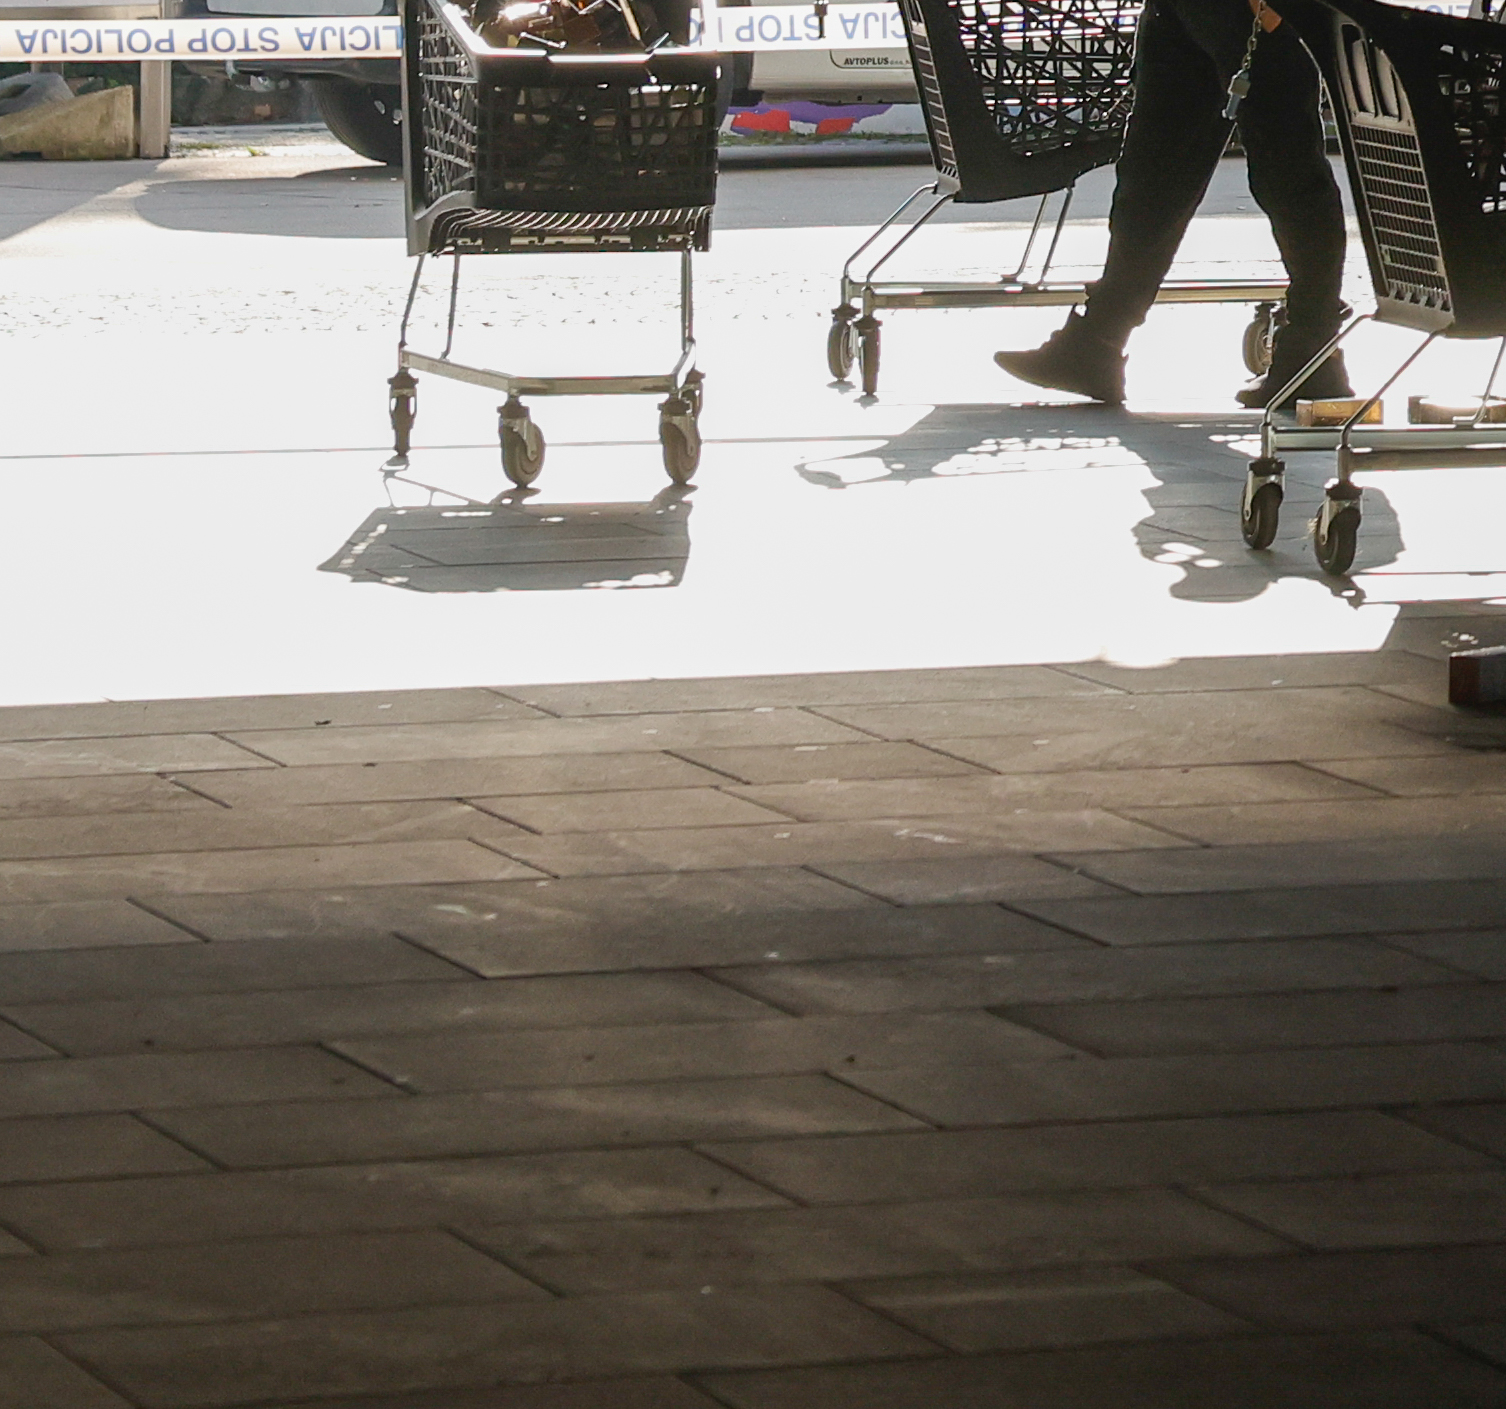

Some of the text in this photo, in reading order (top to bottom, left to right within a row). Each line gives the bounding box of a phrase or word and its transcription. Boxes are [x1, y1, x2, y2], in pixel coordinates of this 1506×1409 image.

[15, 23, 404, 55] LICIJA STOP POLICIJA
[843, 57, 889, 66] AVTOPLUS
